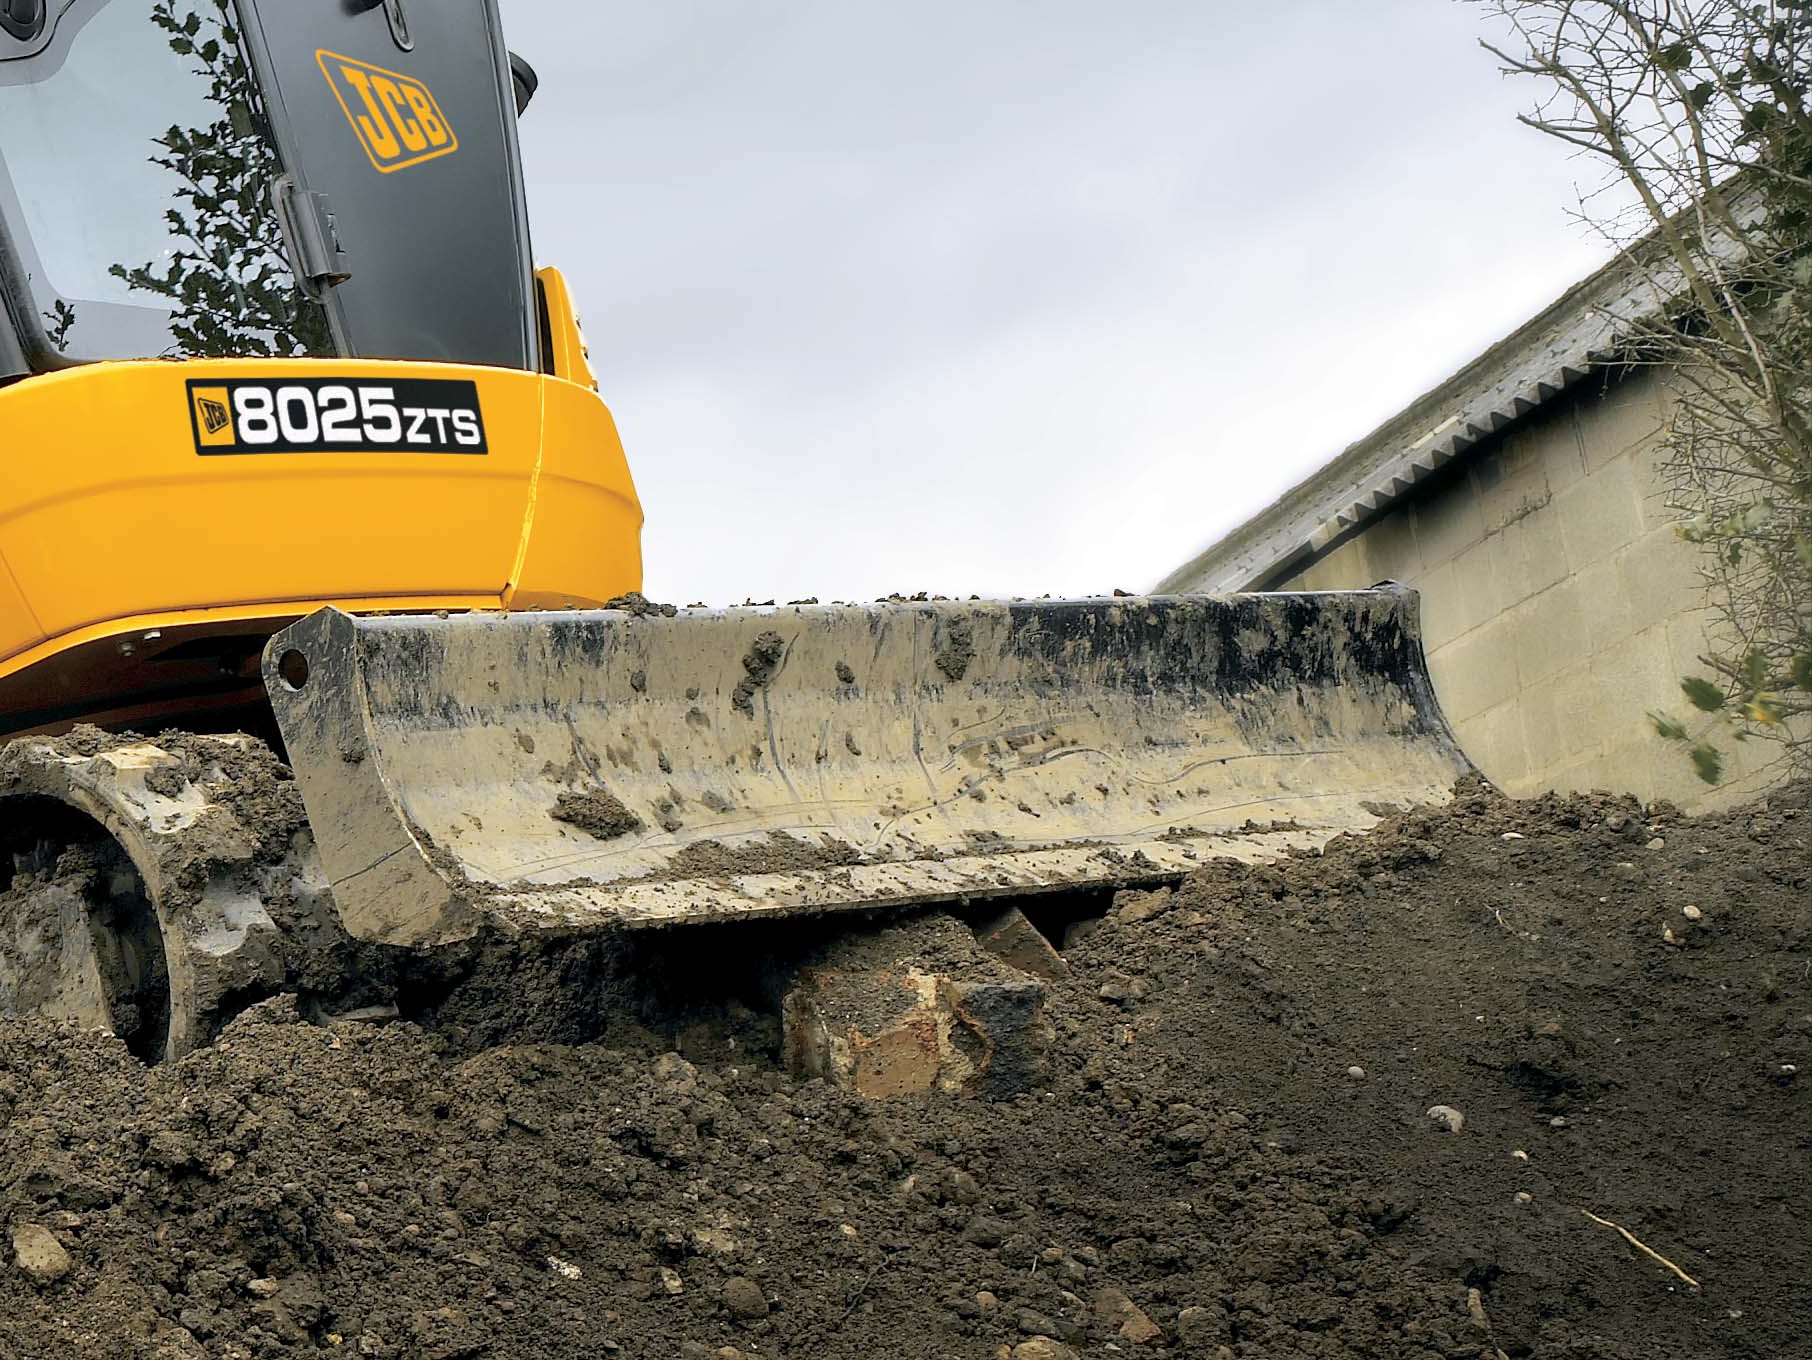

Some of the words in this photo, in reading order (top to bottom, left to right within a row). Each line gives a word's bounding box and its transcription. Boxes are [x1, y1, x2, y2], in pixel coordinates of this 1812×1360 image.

[340, 65, 447, 159] JCB
[202, 402, 227, 429] JCB
[232, 385, 481, 446] 8025ZTS
